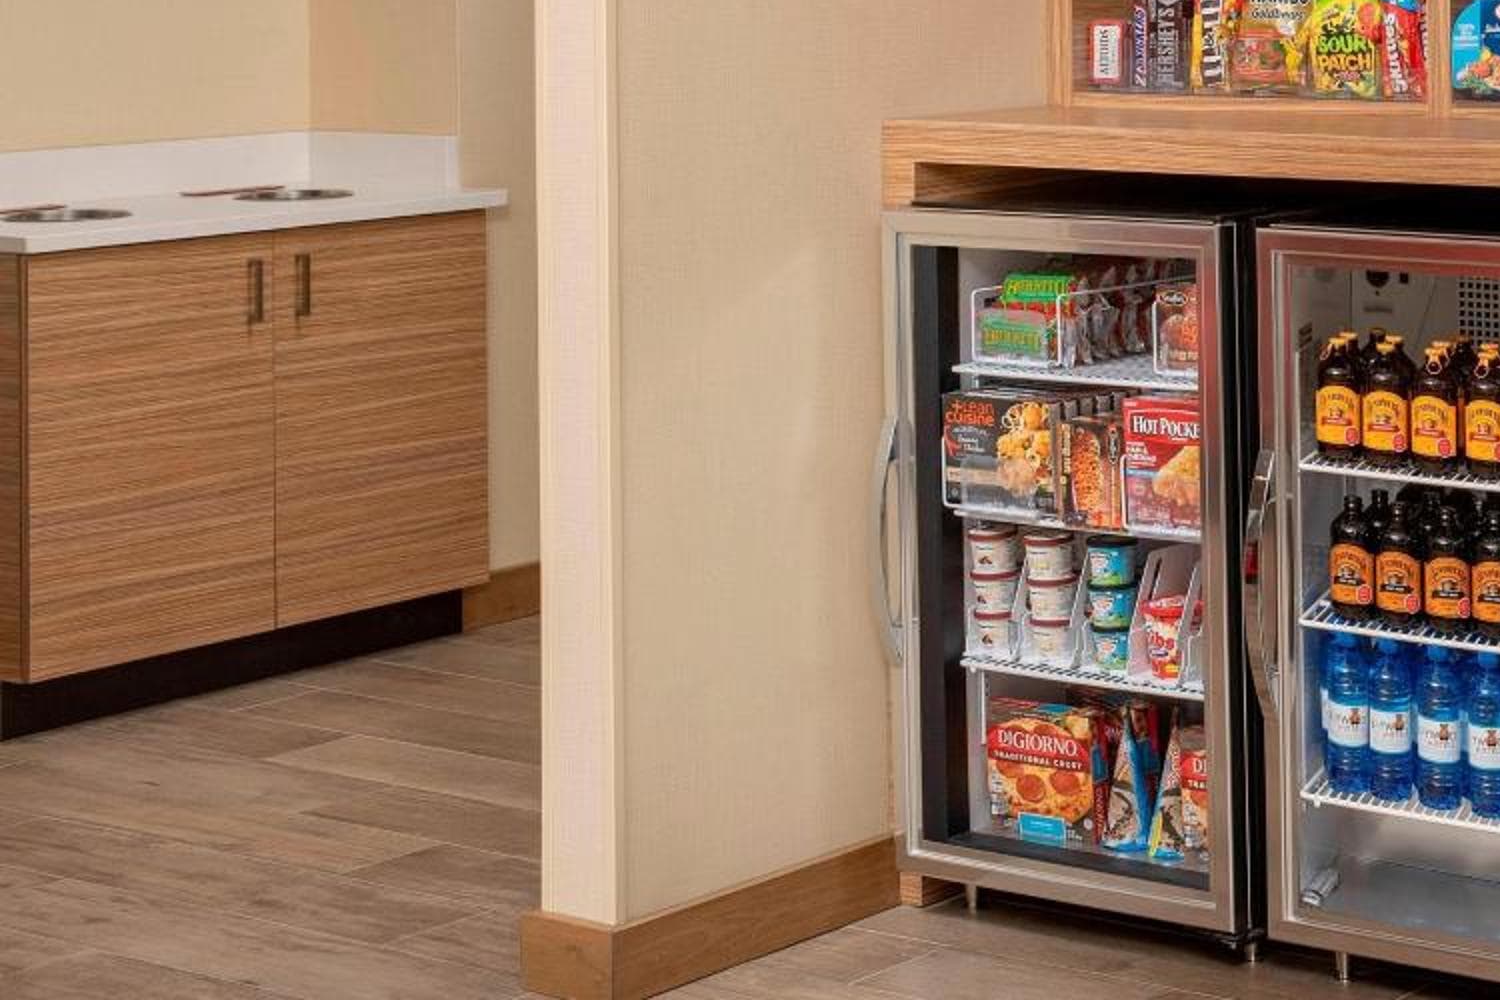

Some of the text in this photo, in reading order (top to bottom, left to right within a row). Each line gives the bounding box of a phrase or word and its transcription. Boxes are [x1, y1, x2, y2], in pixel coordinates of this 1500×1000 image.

[1319, 34, 1368, 53] SOUR
[1319, 53, 1371, 72] PATCH
[1133, 415, 1200, 439] HOT POCKE
[998, 729, 1079, 757] DIGIORNO
